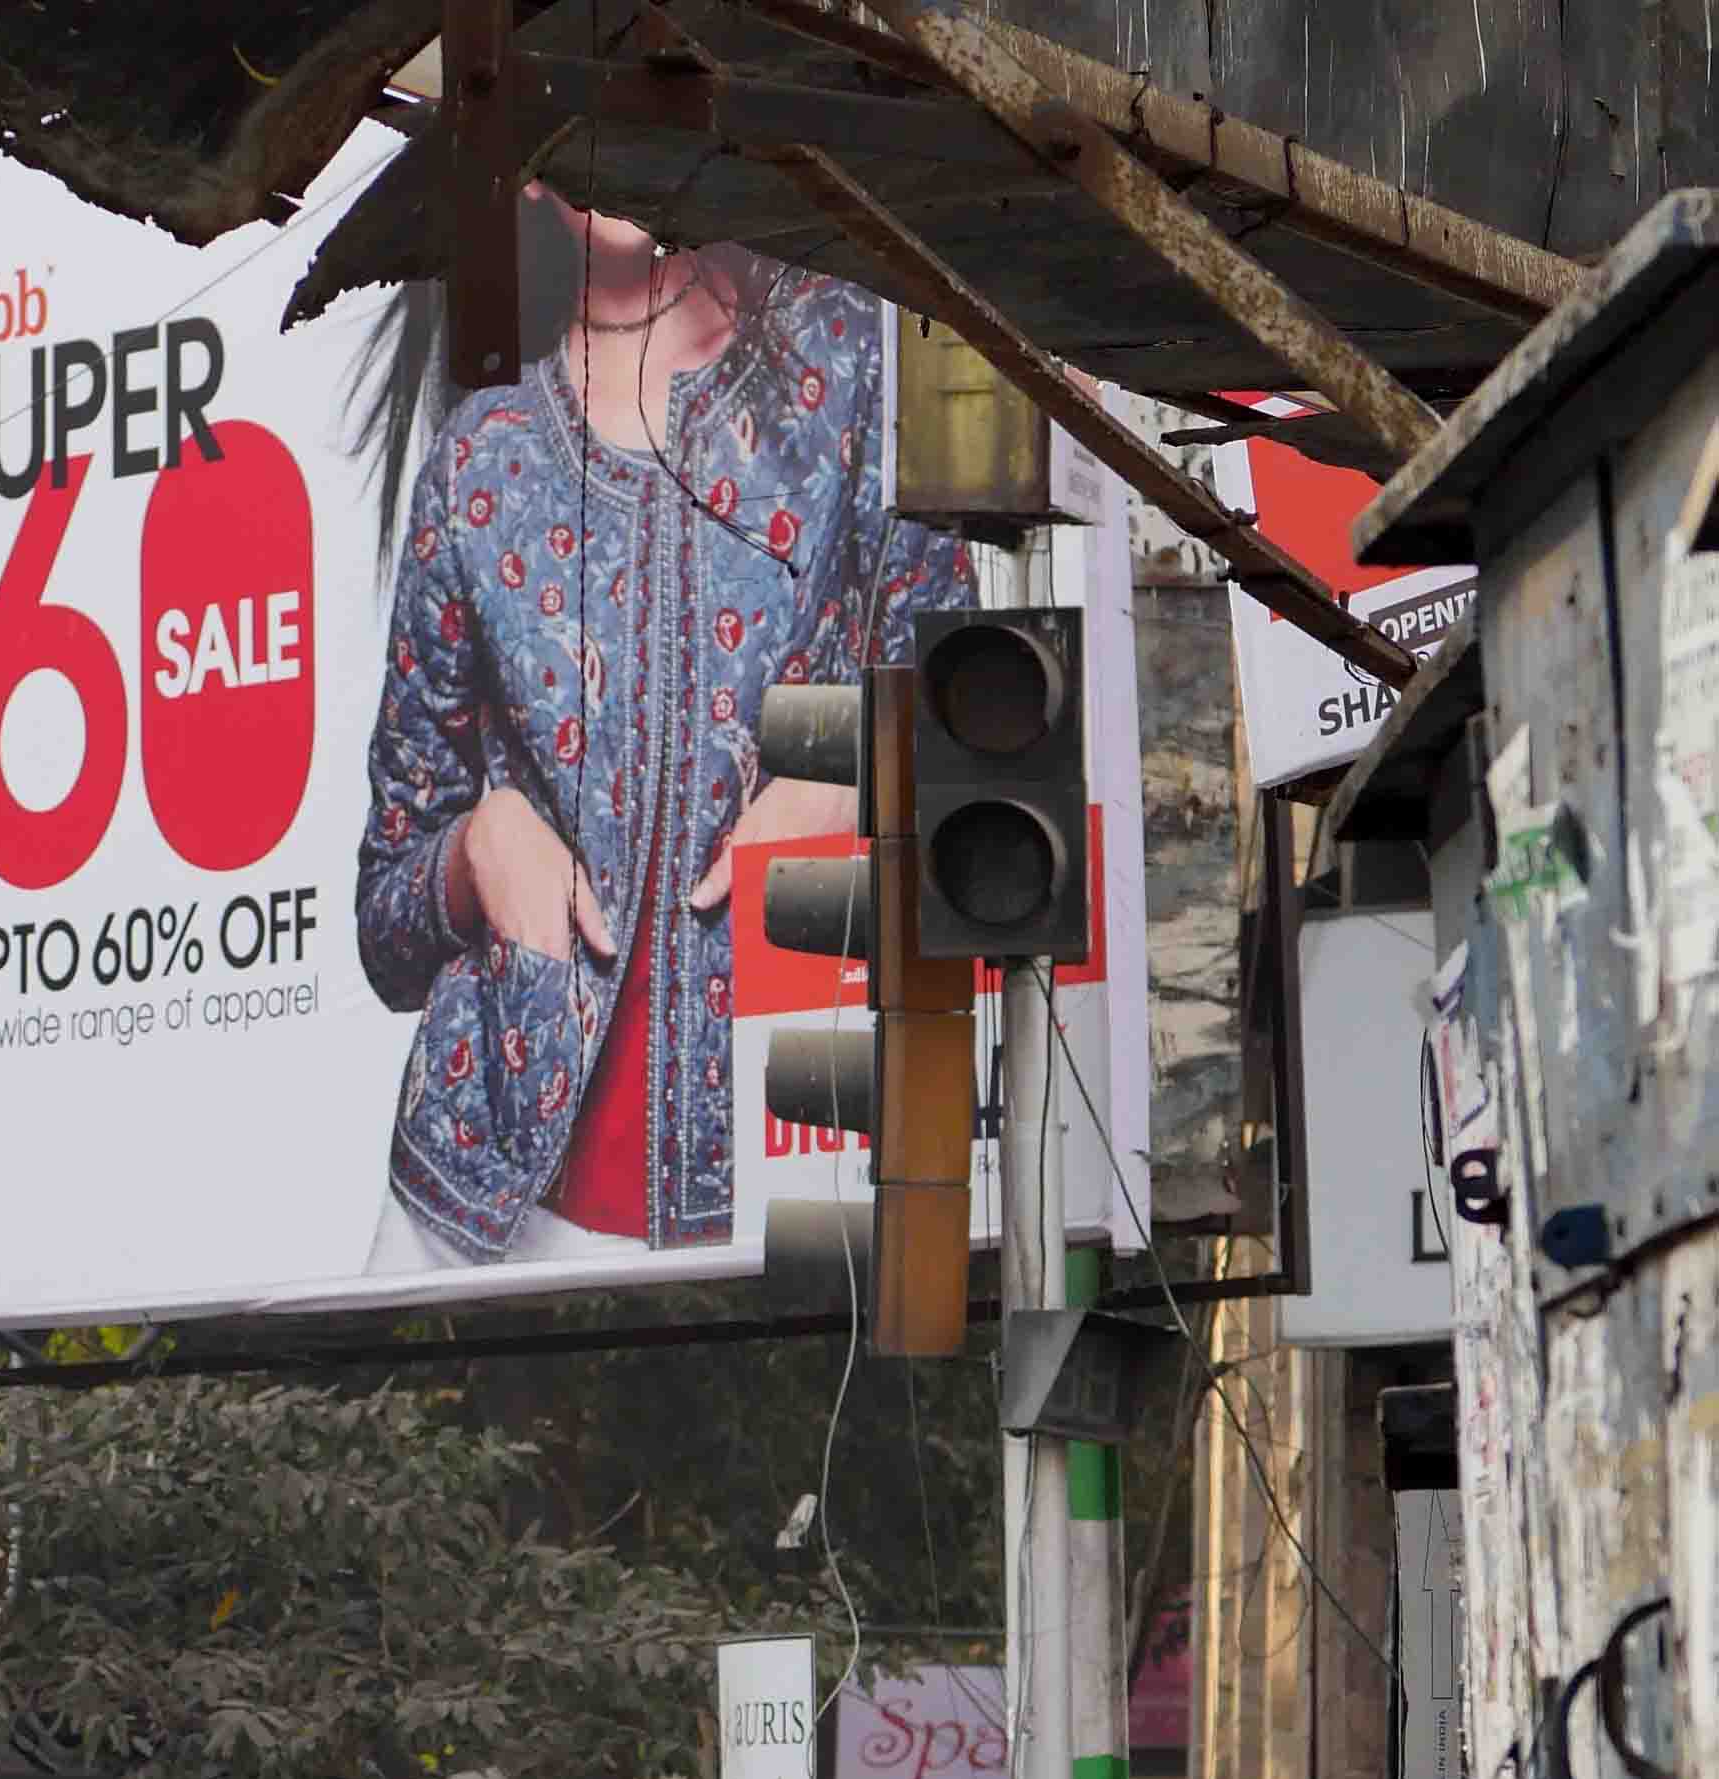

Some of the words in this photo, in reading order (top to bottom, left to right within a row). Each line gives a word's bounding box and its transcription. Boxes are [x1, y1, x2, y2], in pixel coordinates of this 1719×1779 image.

[154, 590, 300, 698] SALE
[92, 901, 204, 986] 60%
[220, 886, 317, 969] OFF
[71, 1001, 153, 1046] range
[165, 989, 193, 1031] of
[203, 973, 319, 1032] apparel
